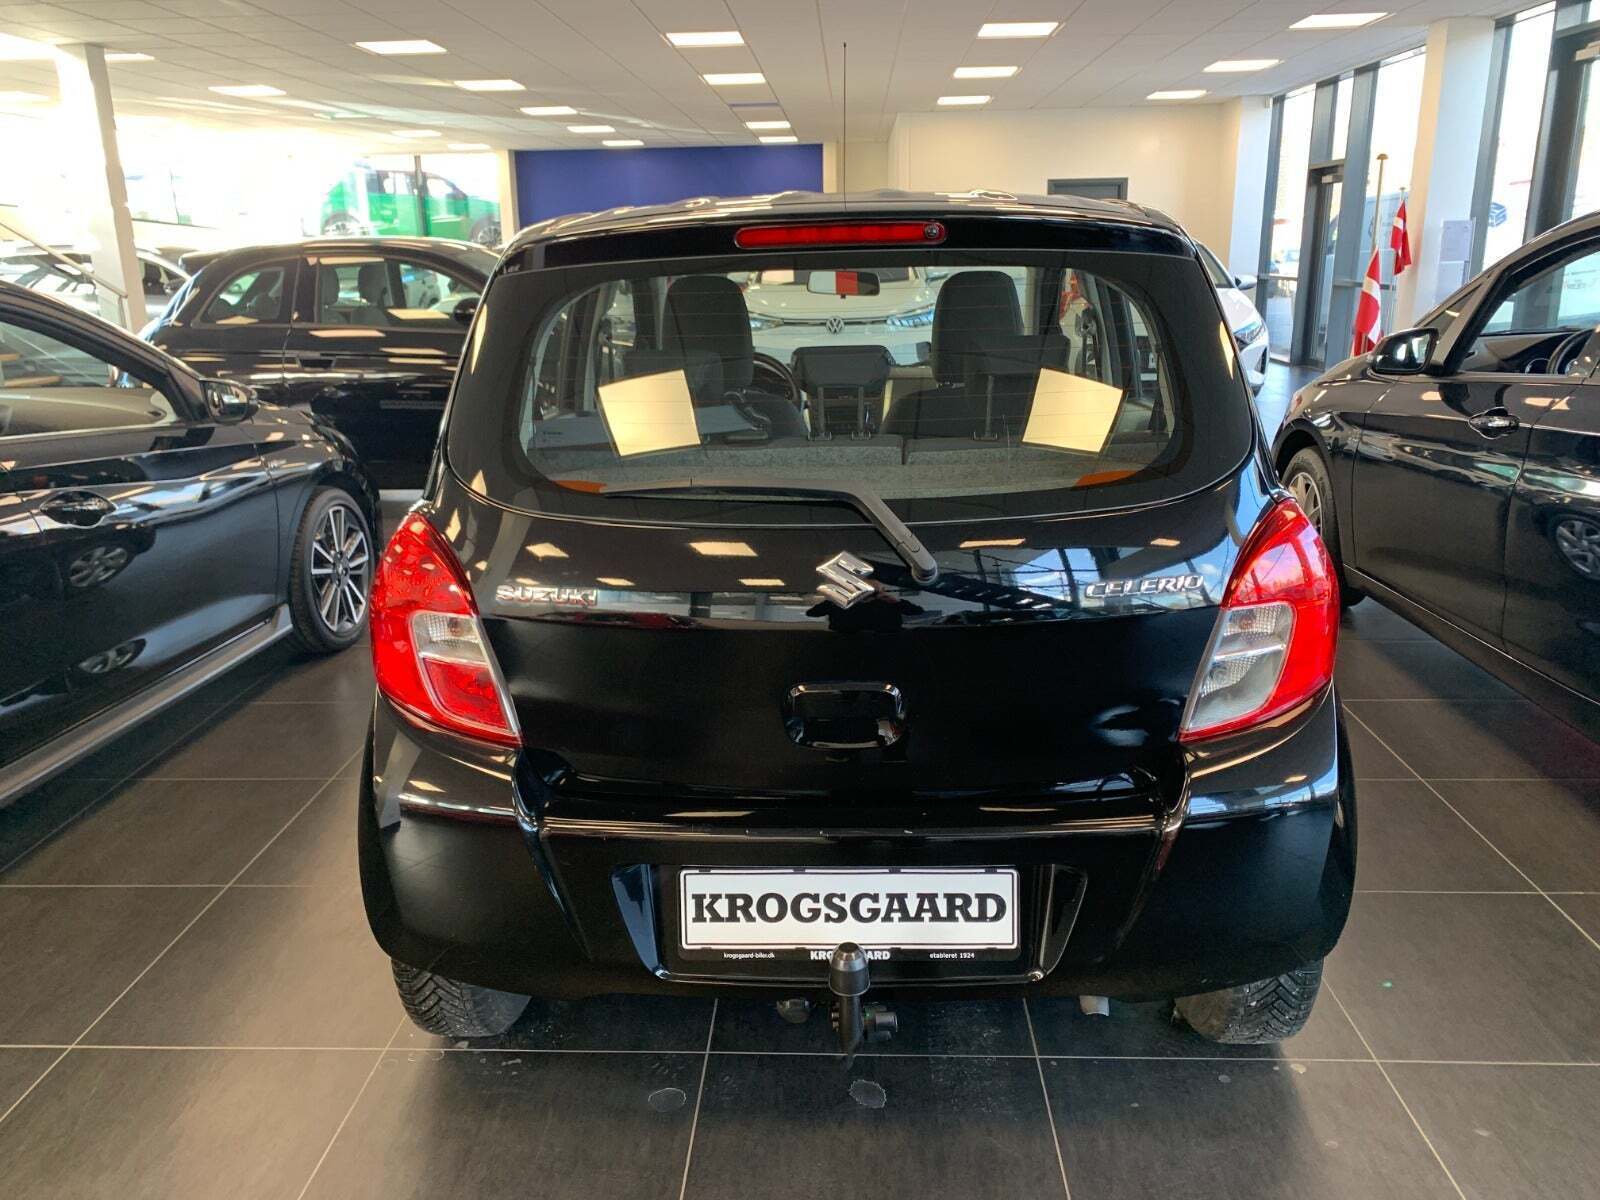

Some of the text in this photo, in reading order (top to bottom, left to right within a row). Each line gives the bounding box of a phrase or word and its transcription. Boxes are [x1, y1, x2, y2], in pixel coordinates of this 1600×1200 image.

[495, 585, 598, 606] SUZUKI
[1084, 575, 1204, 598] CELERIO
[691, 892, 1008, 923] KROGSGAARD
[929, 951, 975, 959] etableret 1924
